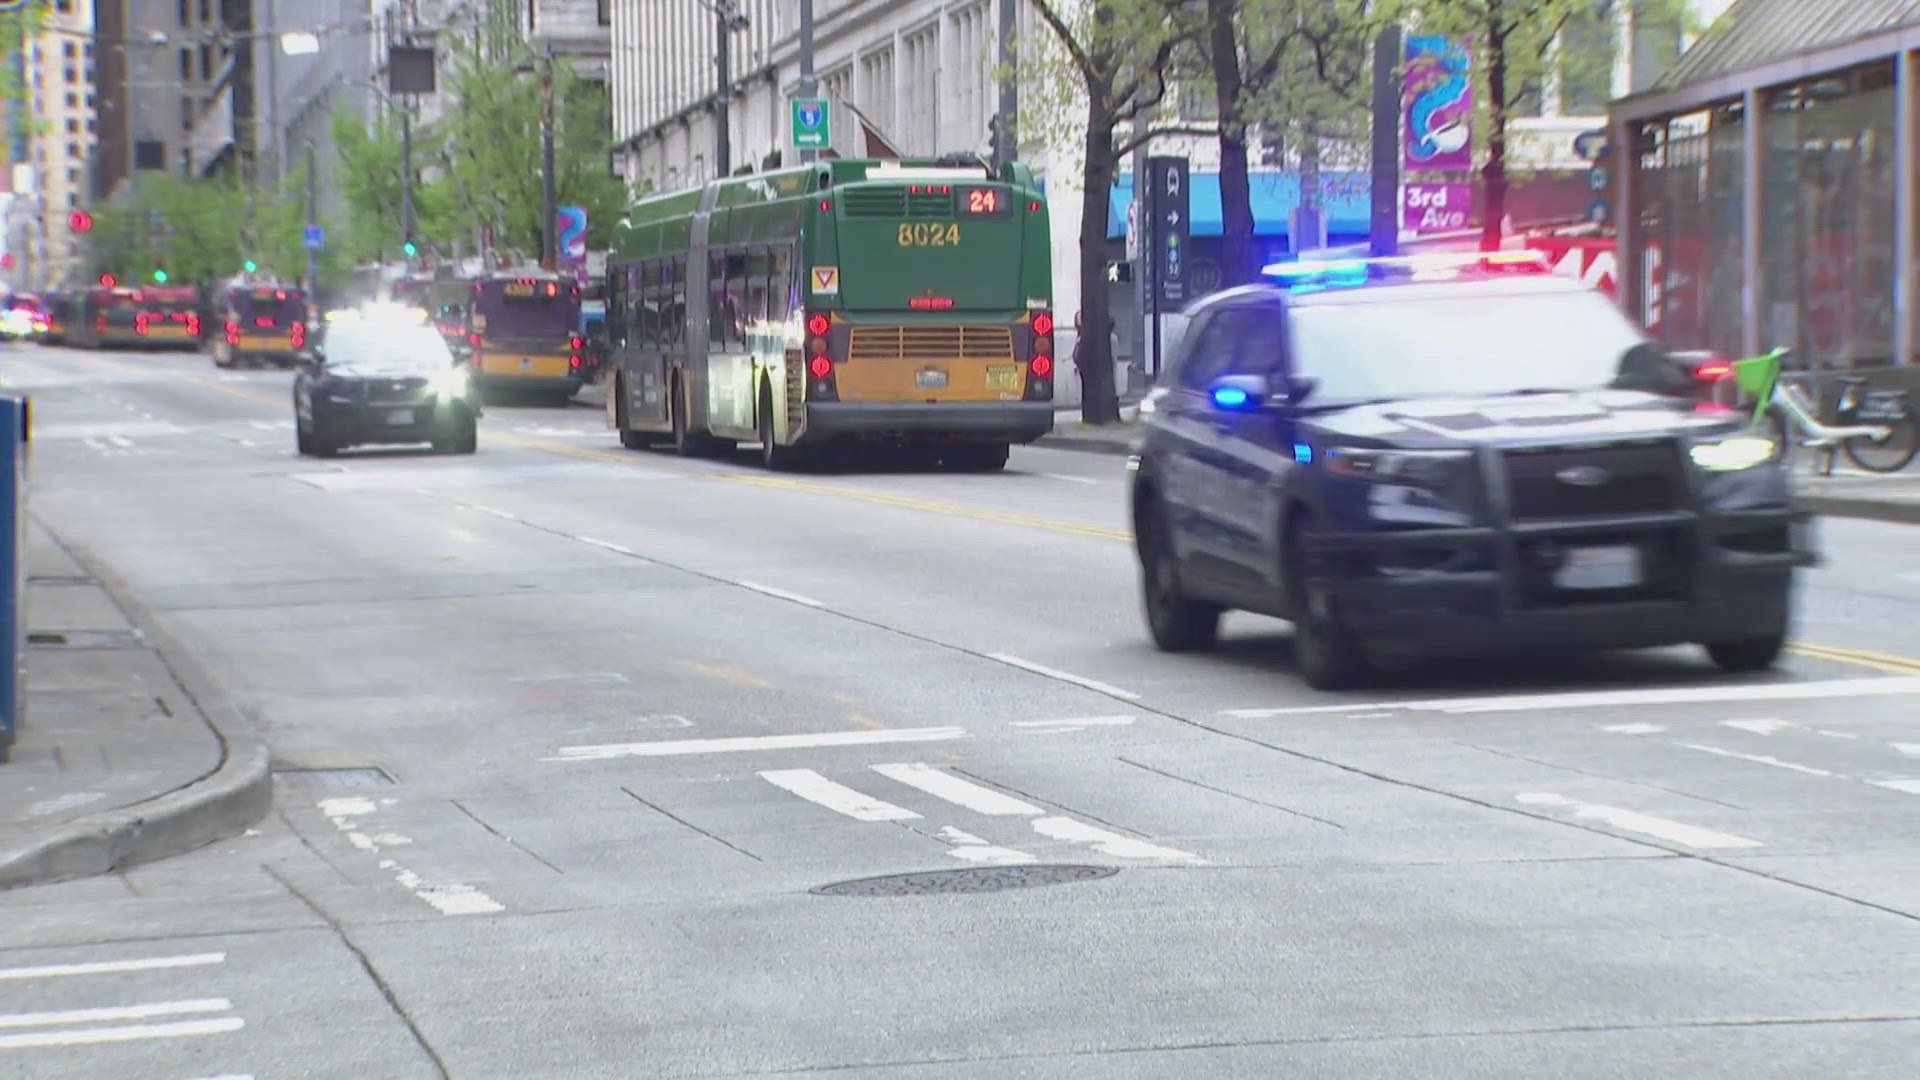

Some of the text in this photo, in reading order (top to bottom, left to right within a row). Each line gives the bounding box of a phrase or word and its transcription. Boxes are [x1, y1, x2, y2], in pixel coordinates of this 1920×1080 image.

[806, 111, 815, 126] 5
[969, 189, 996, 213] 24
[1407, 186, 1448, 208] 3rd
[898, 222, 961, 247] 8024
